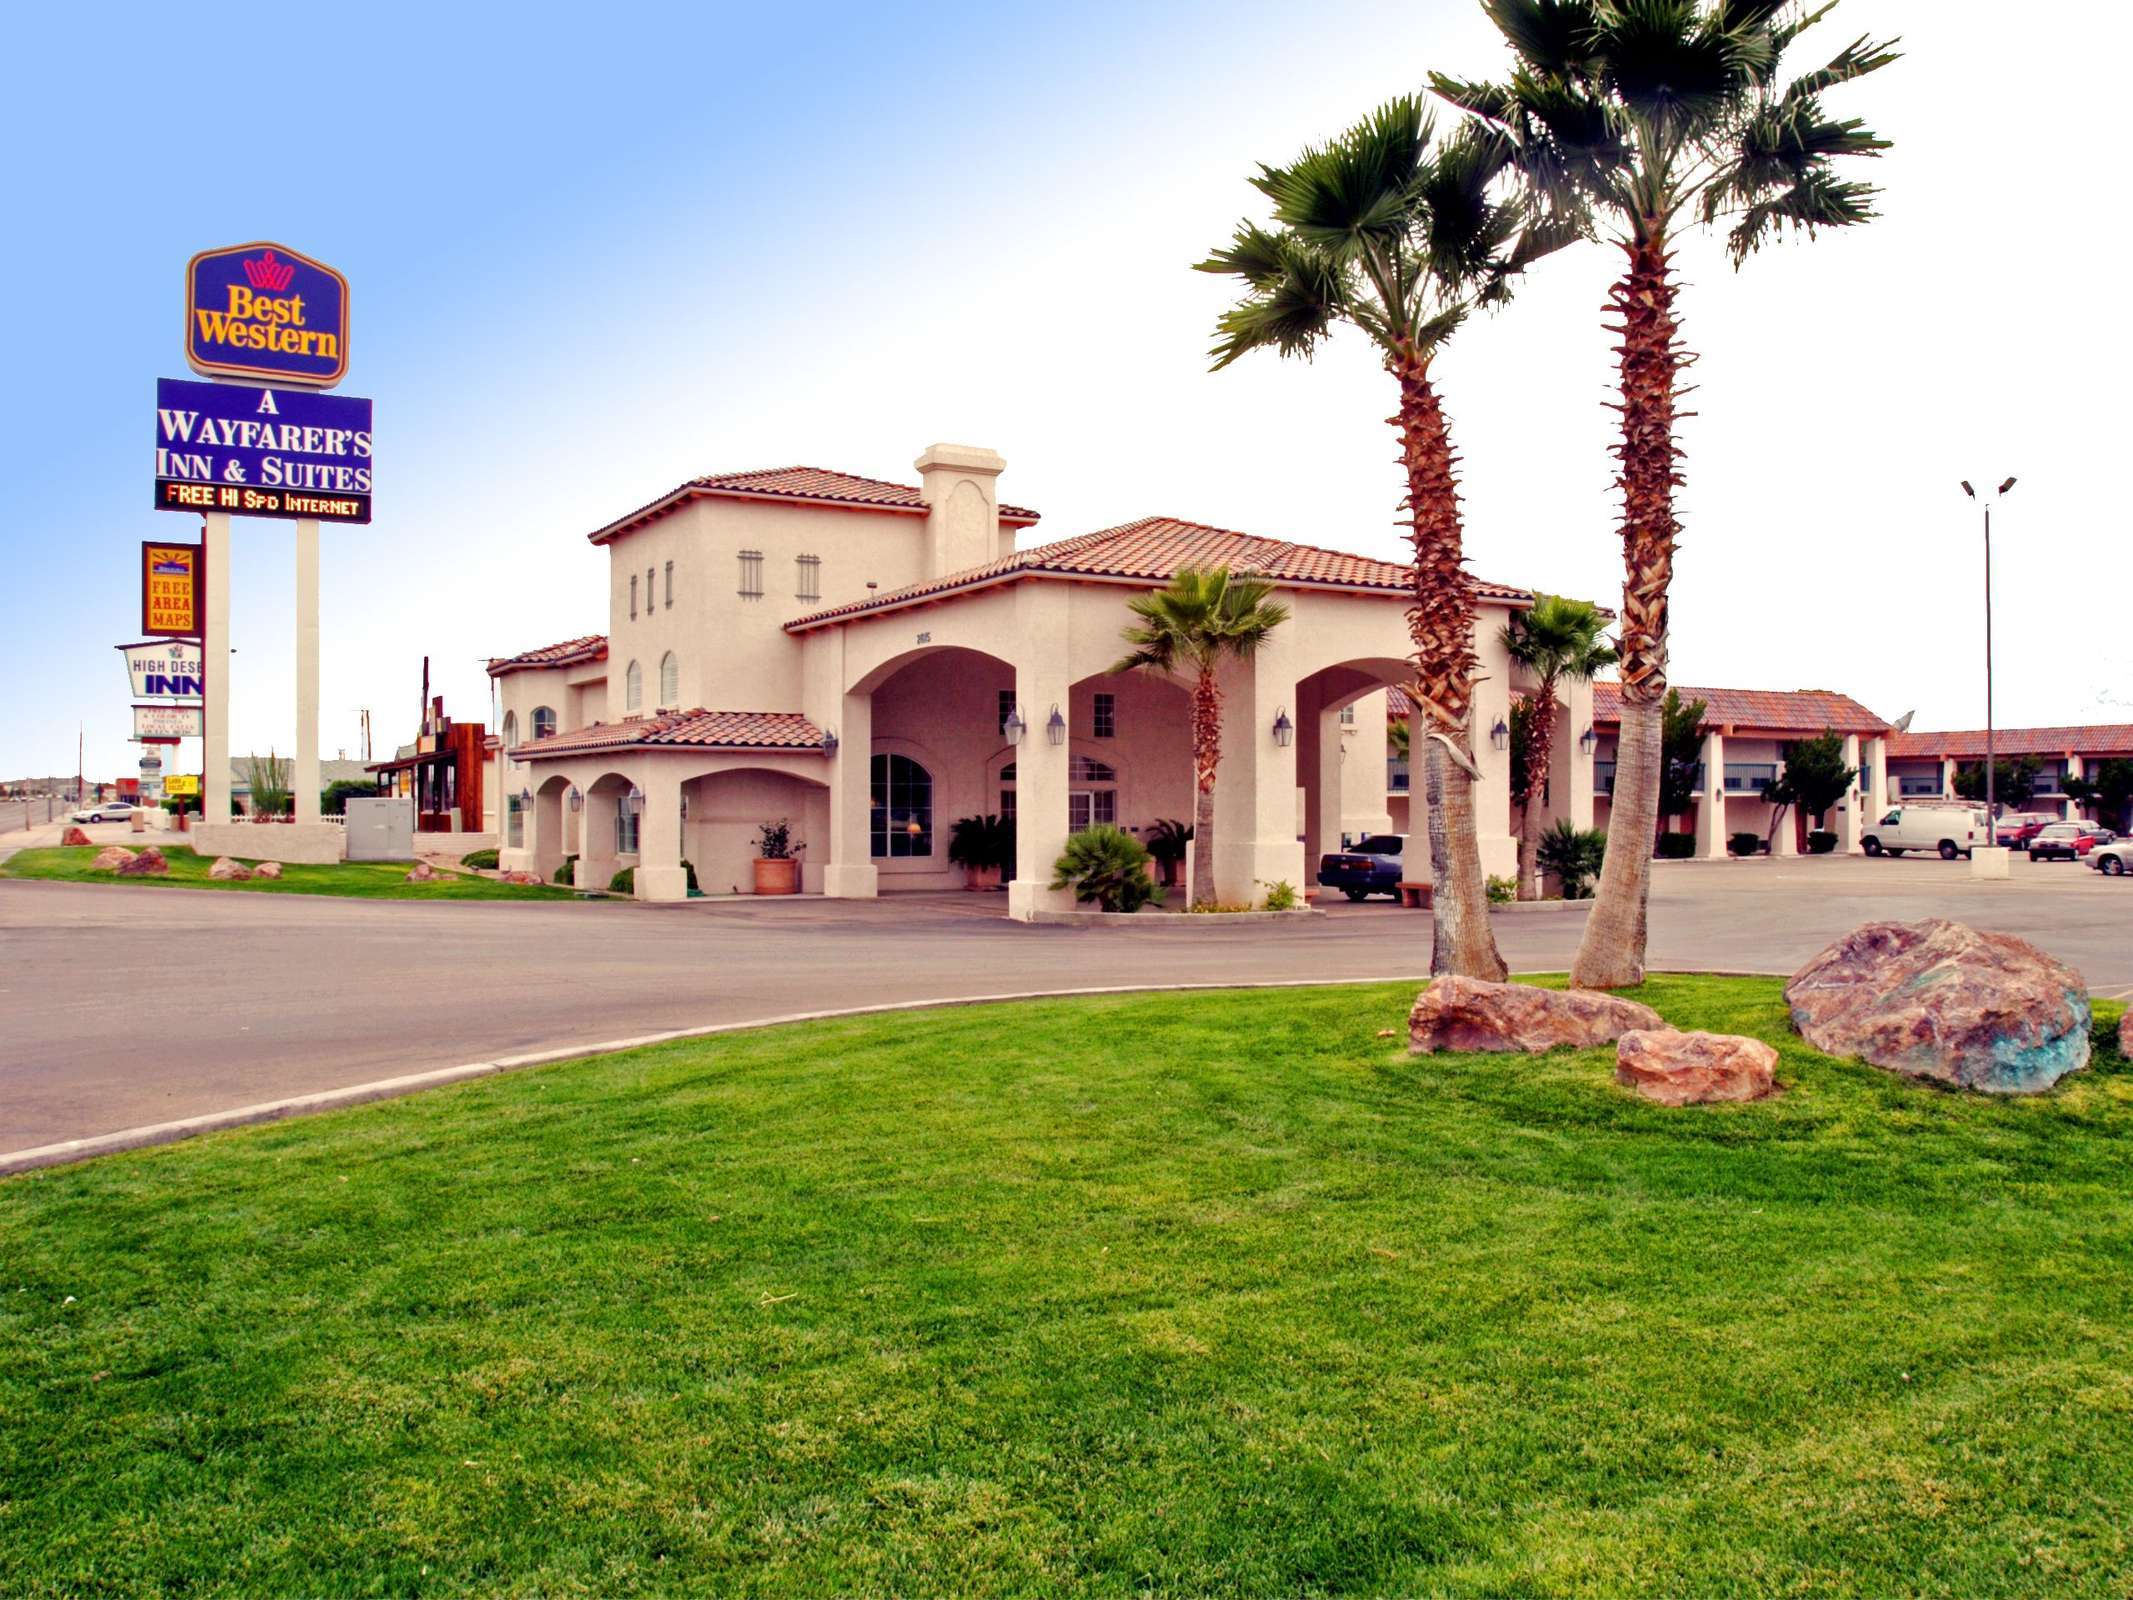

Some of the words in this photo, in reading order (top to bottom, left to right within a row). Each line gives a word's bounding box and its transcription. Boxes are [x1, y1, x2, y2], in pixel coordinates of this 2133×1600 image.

[226, 284, 306, 326] Best
[195, 308, 338, 358] Western
[256, 389, 280, 414] A
[157, 448, 213, 480] INN
[224, 459, 247, 482] &
[261, 456, 371, 491] SUITES
[167, 484, 215, 505] FREE
[221, 487, 239, 507] HI
[285, 493, 359, 515] INTERNET
[152, 581, 190, 595] FREE
[153, 597, 191, 611] AREA
[153, 613, 191, 627] MAPS
[133, 660, 165, 672] HIGH
[145, 675, 203, 695] INN
